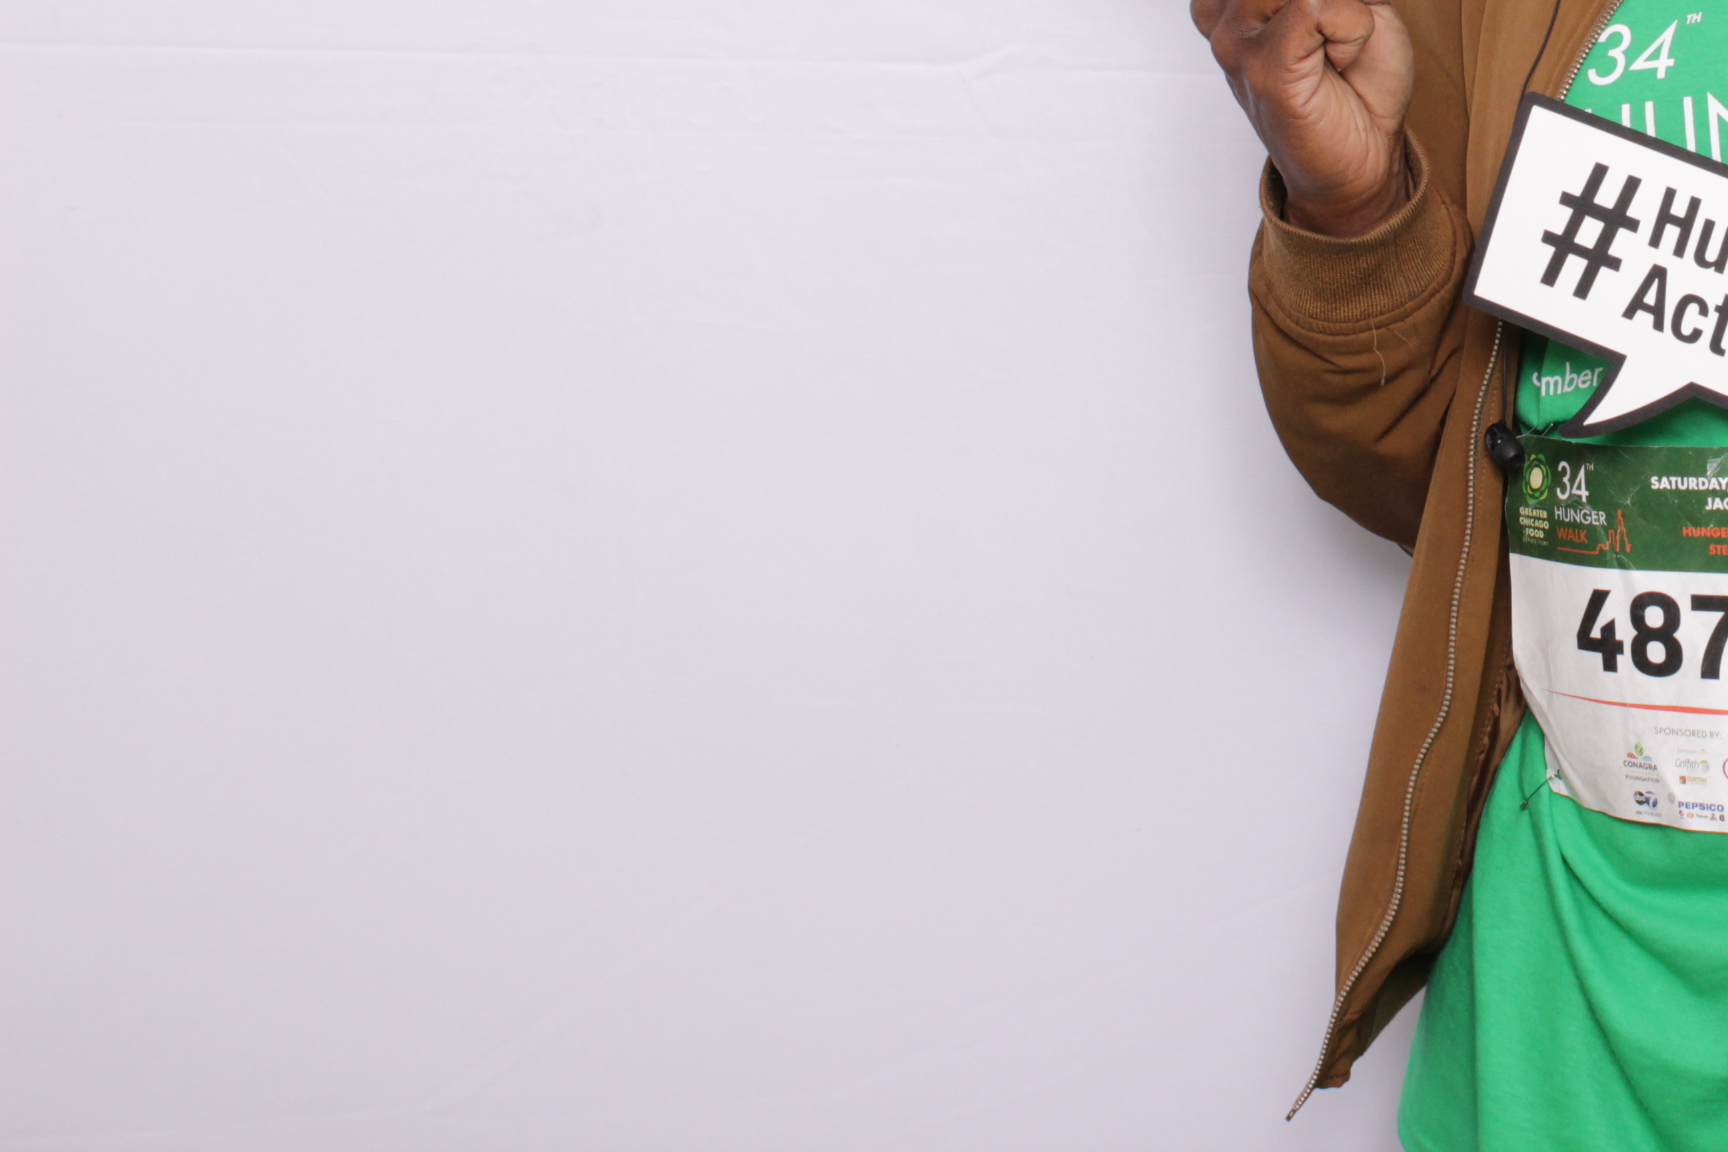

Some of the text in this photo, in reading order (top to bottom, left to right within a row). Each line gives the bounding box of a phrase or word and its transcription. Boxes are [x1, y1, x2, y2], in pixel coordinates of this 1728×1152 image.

[1519, 506, 1548, 520] GREATER
[1554, 506, 1608, 526] HUNGER
[1519, 516, 1550, 530] CHICAGO
[1524, 528, 1545, 539] FOOD
[1556, 527, 1589, 544] WALK
[1654, 726, 1722, 740] SPONSORED BY:
[1623, 759, 1658, 771] CONAGRA
[1677, 801, 1725, 813] PEPSICO
